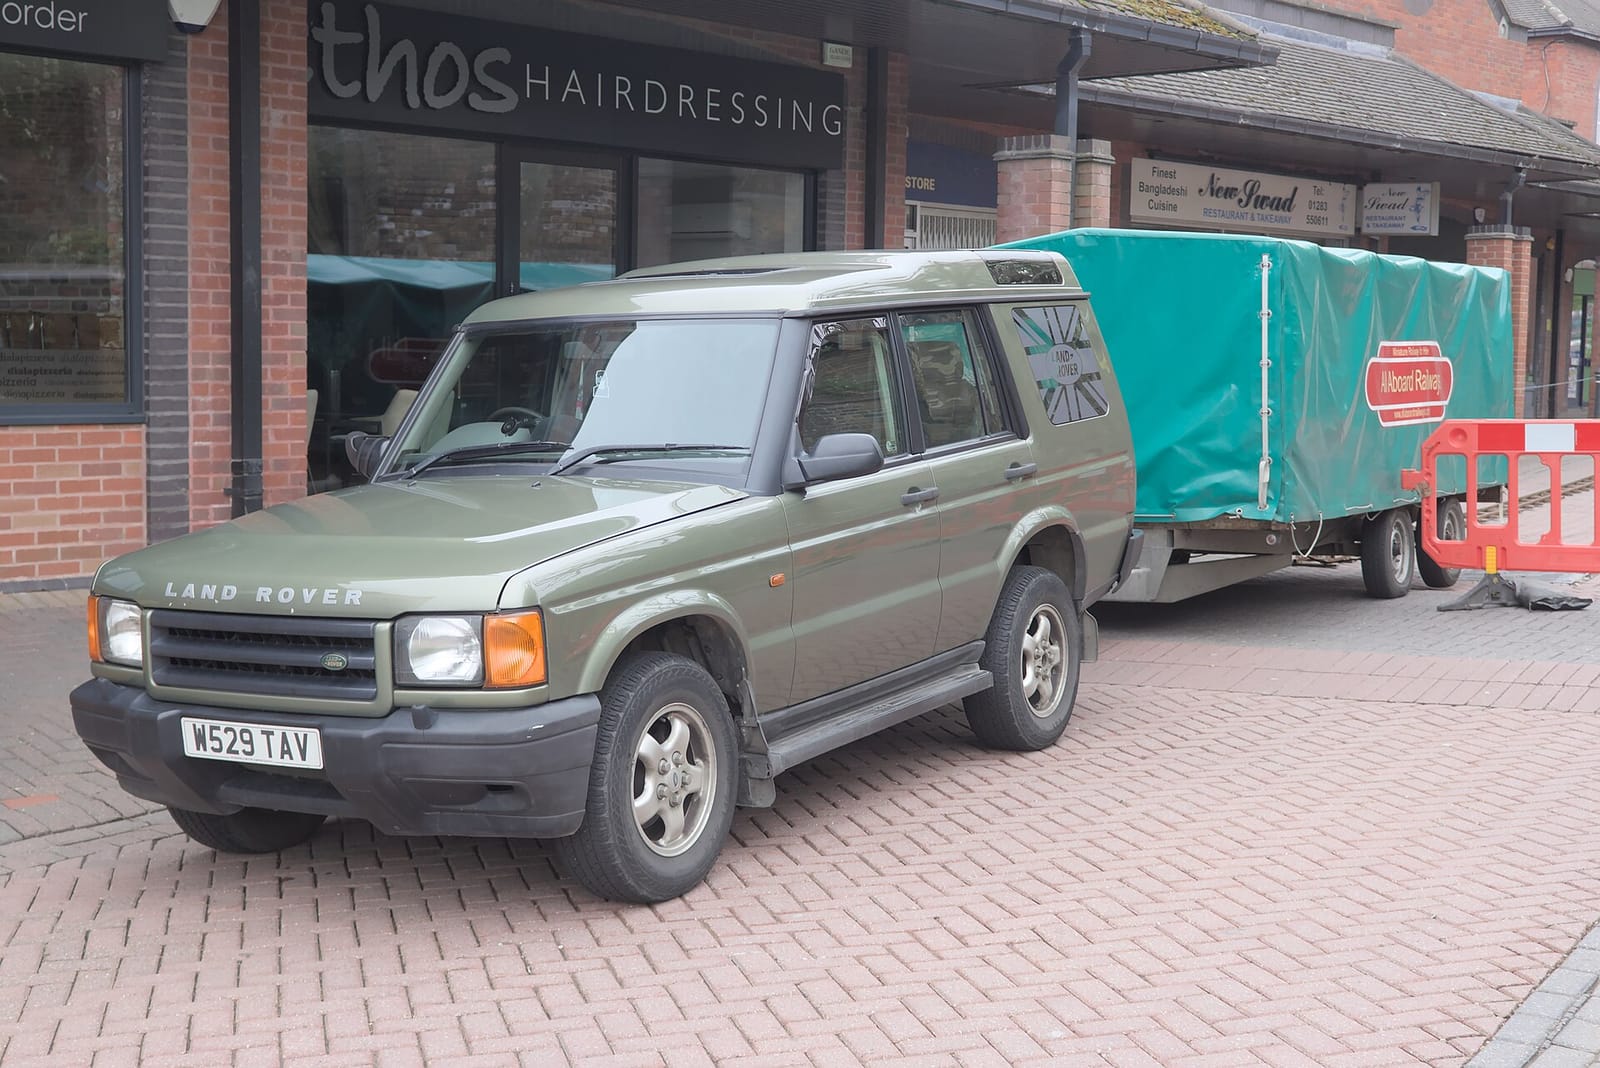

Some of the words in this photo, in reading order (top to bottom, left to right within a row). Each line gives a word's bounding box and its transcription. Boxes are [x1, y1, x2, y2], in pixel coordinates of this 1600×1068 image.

[2, 0, 89, 33] order
[307, 1, 519, 113] thos
[526, 63, 842, 136] HAIRDRESSING
[1151, 166, 1177, 180] Finest
[905, 175, 936, 191] STORE
[1138, 181, 1188, 197] Bangladeshi
[1312, 185, 1325, 197] Tel:
[1198, 172, 1239, 200] New
[1238, 179, 1298, 213] Swad
[1147, 198, 1178, 212] Cuisine
[1307, 201, 1328, 212] 01283
[1202, 207, 1249, 221] RESTAURANT
[1249, 211, 1256, 222] &
[1256, 212, 1293, 225] TAKEAWAY
[1305, 214, 1329, 227] 550611
[164, 582, 238, 600] LAND
[255, 586, 364, 605] ROVER
[192, 723, 255, 757] W529
[260, 729, 308, 762] TAV
